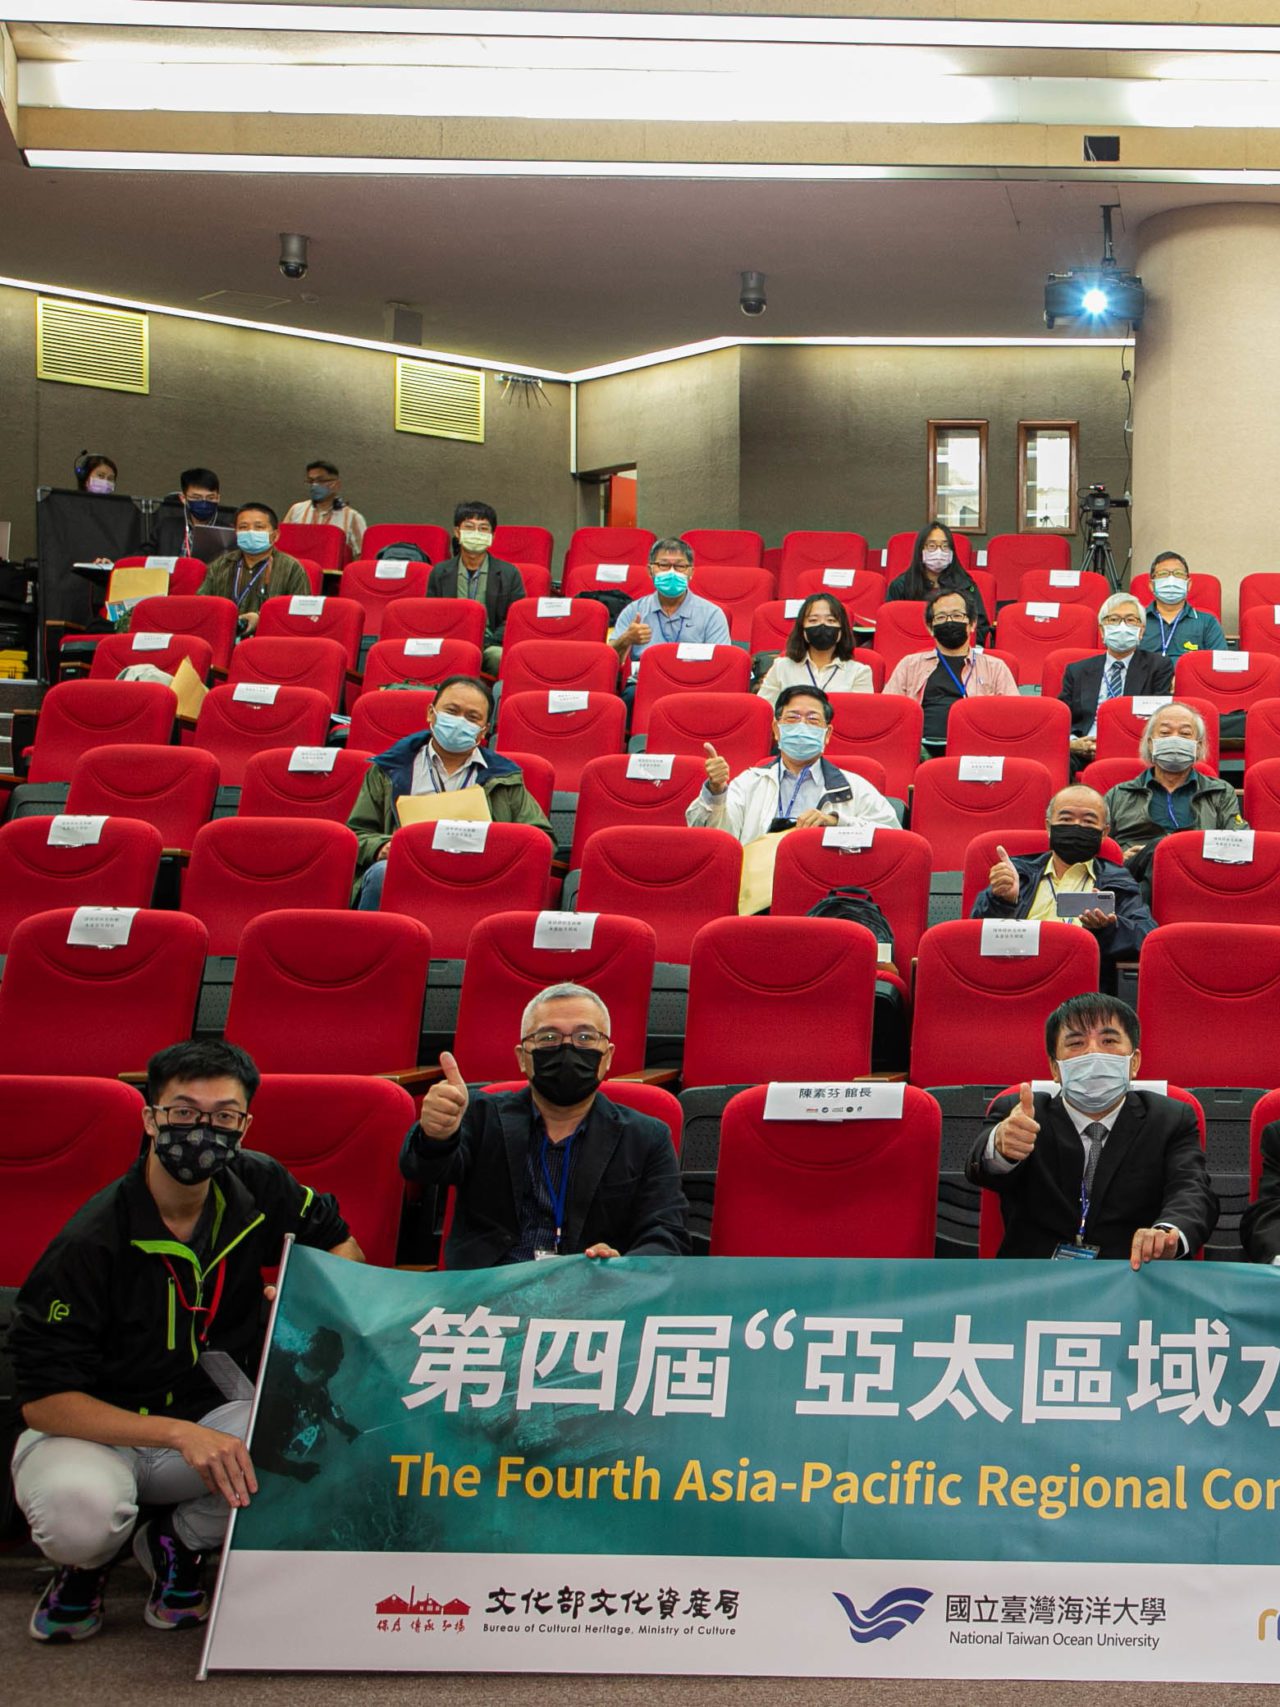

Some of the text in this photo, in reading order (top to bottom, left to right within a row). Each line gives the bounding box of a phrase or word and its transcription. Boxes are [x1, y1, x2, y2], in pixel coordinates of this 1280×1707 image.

[845, 1087, 872, 1098] 館長
[390, 1453, 480, 1497] The
[497, 1456, 659, 1500] Fourth
[674, 1458, 960, 1506] Asia-Pacific
[978, 1464, 1187, 1519] Regional
[945, 1594, 1167, 1626] 國立臺灣海洋大學
[482, 1623, 521, 1633] Bureau
[524, 1623, 535, 1633] of
[538, 1623, 581, 1634] Cultural
[637, 1624, 680, 1637] Ministry
[683, 1625, 694, 1635] of
[697, 1625, 736, 1636] Culture
[949, 1630, 1160, 1651] National Taiwan Ocean University
